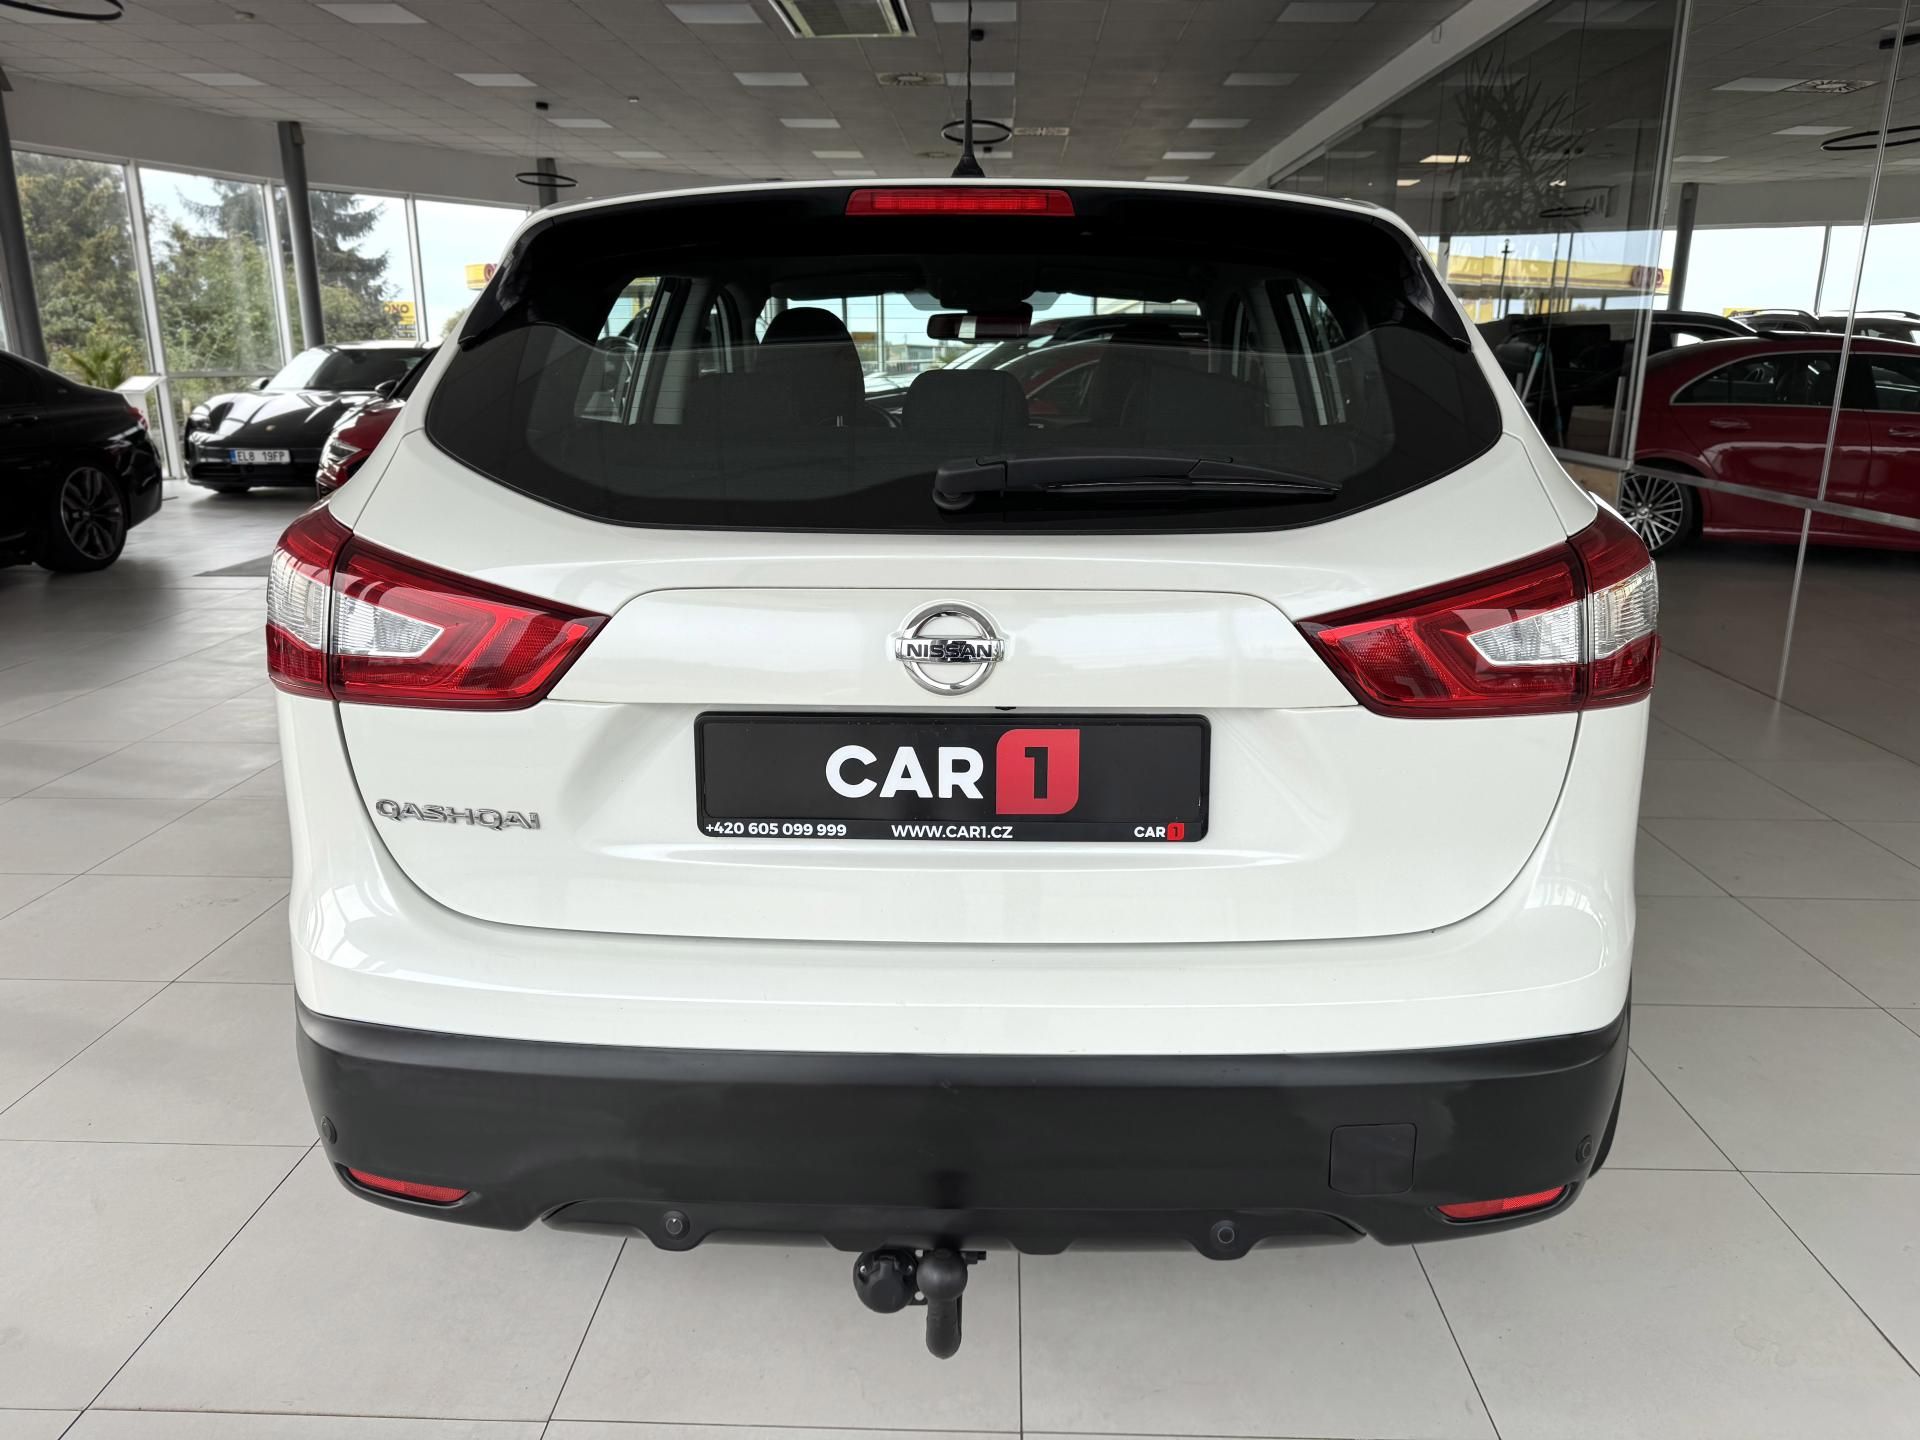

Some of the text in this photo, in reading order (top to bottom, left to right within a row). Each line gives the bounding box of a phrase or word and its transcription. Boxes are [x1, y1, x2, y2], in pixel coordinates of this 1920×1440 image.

[906, 643, 993, 658] NISSAN
[375, 799, 541, 831] QASHQAI
[705, 822, 847, 837] +420 605 099 999
[891, 824, 1013, 839] WWW.CAR1.CZ
